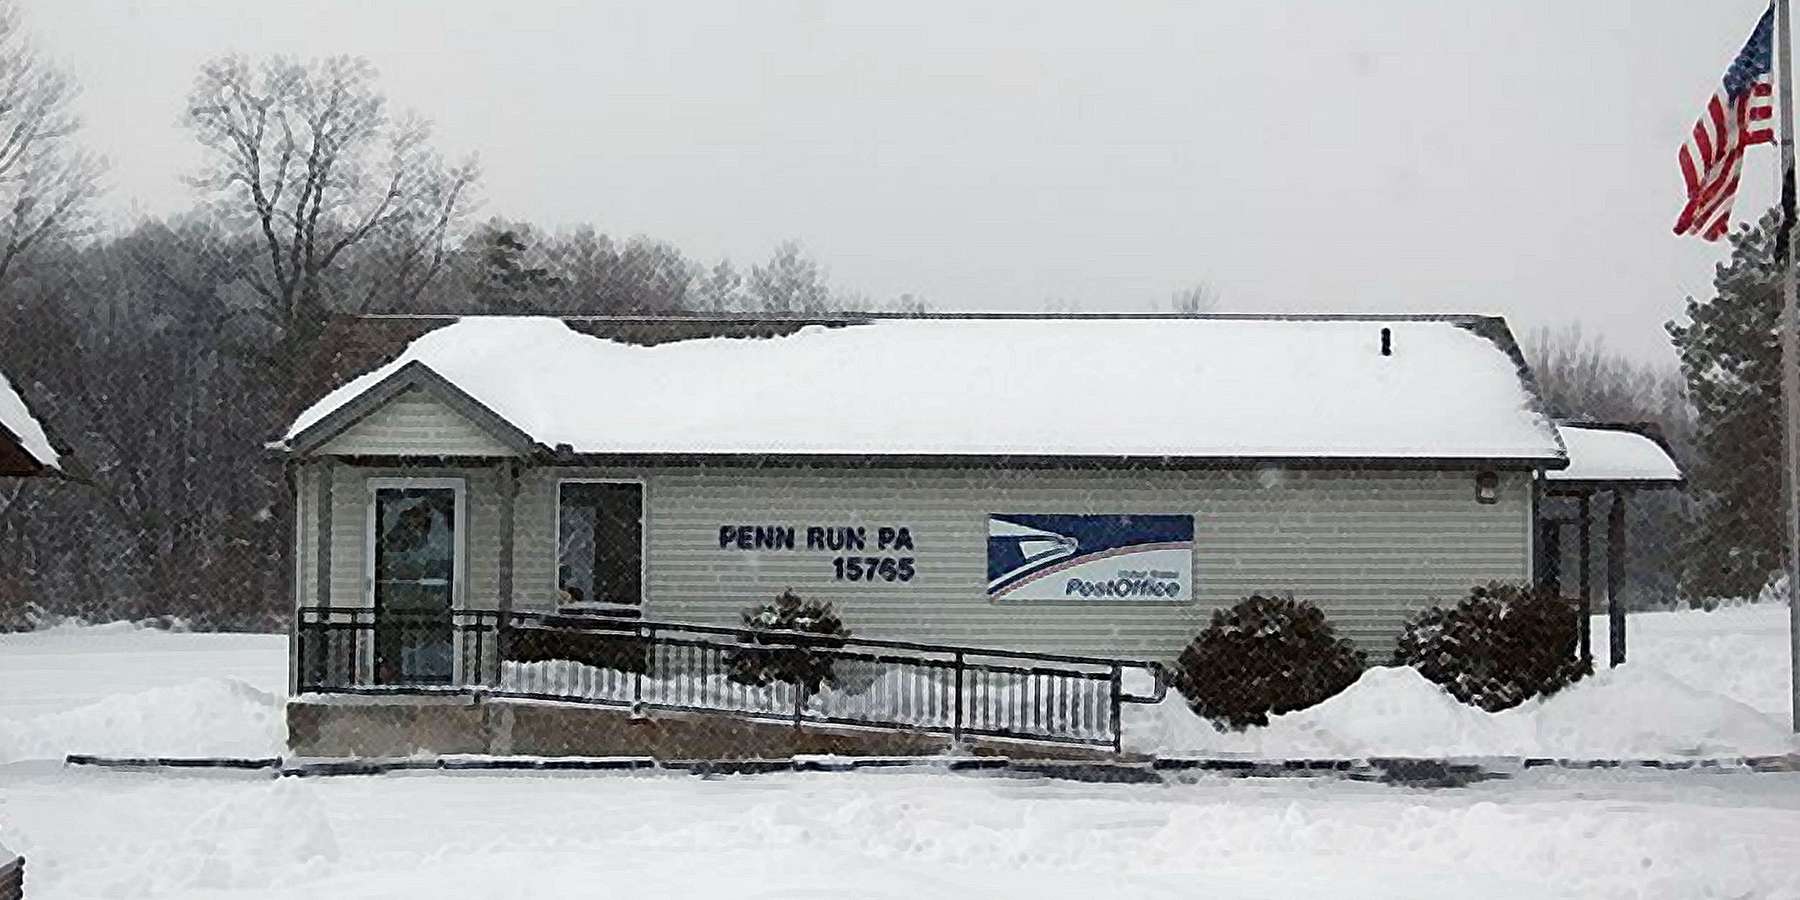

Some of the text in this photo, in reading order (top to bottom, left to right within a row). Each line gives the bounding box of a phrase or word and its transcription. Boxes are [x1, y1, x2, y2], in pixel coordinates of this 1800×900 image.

[719, 525, 915, 551] PENN RUN PA
[832, 556, 916, 583] 15765
